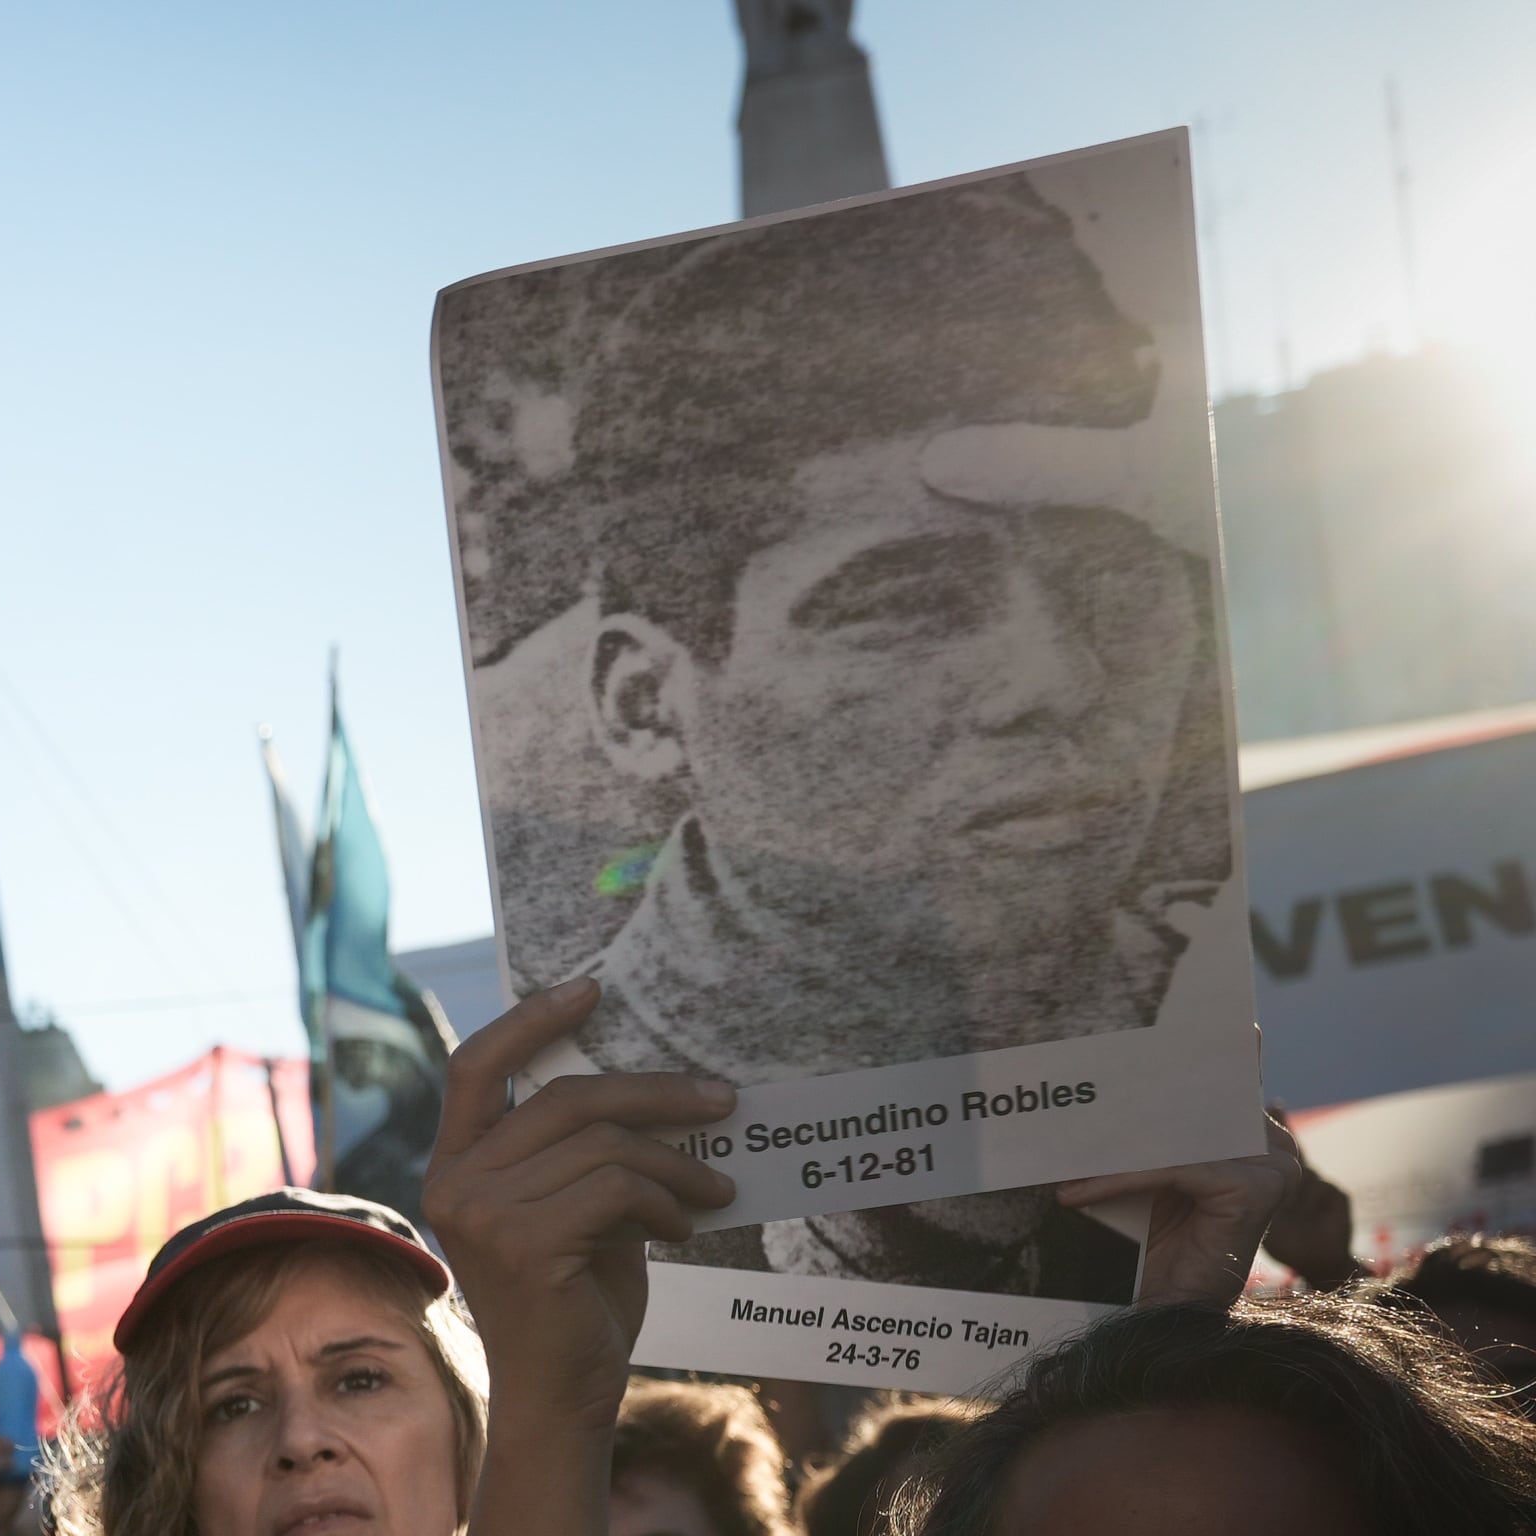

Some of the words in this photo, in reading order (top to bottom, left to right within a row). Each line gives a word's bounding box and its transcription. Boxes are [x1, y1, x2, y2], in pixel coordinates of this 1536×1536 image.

[676, 1131, 734, 1161] lio
[744, 1103, 948, 1154] Secundino
[960, 1080, 1097, 1121] Robles
[801, 1143, 935, 1190] 6-12-81
[730, 1298, 824, 1328] Manuel
[831, 1308, 953, 1340] Ascencio
[961, 1319, 1029, 1349] Tajan
[826, 1342, 921, 1371] 24-3-76
